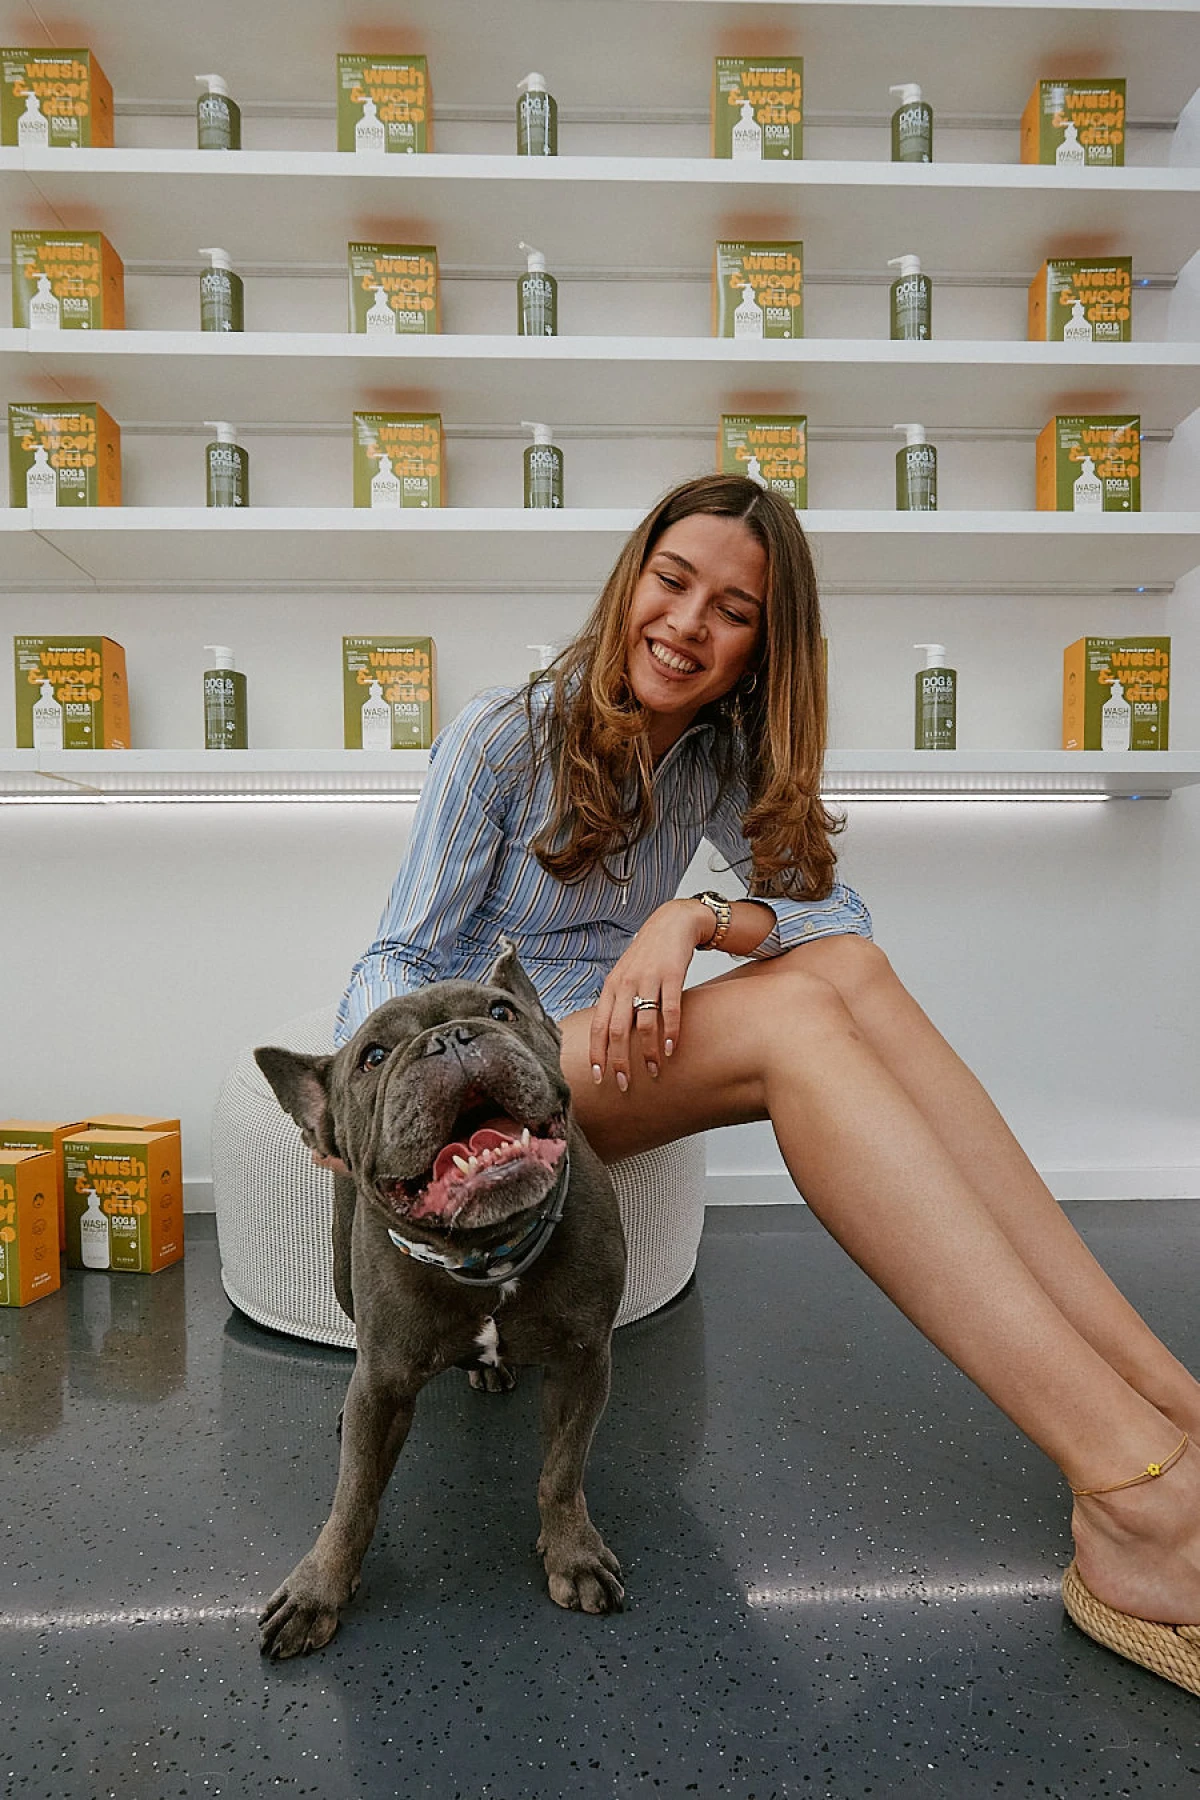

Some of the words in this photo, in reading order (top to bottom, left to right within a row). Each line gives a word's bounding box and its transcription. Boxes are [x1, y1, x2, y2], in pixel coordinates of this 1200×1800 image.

[25, 60, 88, 79] wash
[363, 67, 424, 85] wash
[741, 68, 800, 87] wash
[43, 97, 88, 116] duo
[1065, 90, 1124, 109] wash
[380, 103, 424, 122] duo
[757, 105, 801, 124] duo
[1080, 127, 1123, 145] duo
[37, 243, 99, 261] wash
[375, 257, 434, 275] wash
[742, 253, 800, 271] wash
[1072, 268, 1129, 286] wash
[54, 279, 100, 297] duo
[390, 292, 435, 311] duo
[759, 288, 800, 307] duo
[1088, 304, 1129, 321] duo
[35, 414, 95, 432] wash
[379, 424, 438, 442] wash
[747, 426, 805, 444] wash
[1082, 426, 1139, 443] wash
[51, 449, 96, 468] duo
[395, 459, 438, 477] duo
[763, 460, 805, 479] duo
[1097, 460, 1139, 477] duo
[40, 648, 100, 666] wash
[369, 648, 429, 667] wash
[1111, 649, 1168, 666] wash
[57, 683, 101, 702] duo
[385, 684, 430, 702] duo
[1126, 684, 1168, 701] duo
[87, 1157, 145, 1176] wash
[103, 1196, 147, 1215] duo
